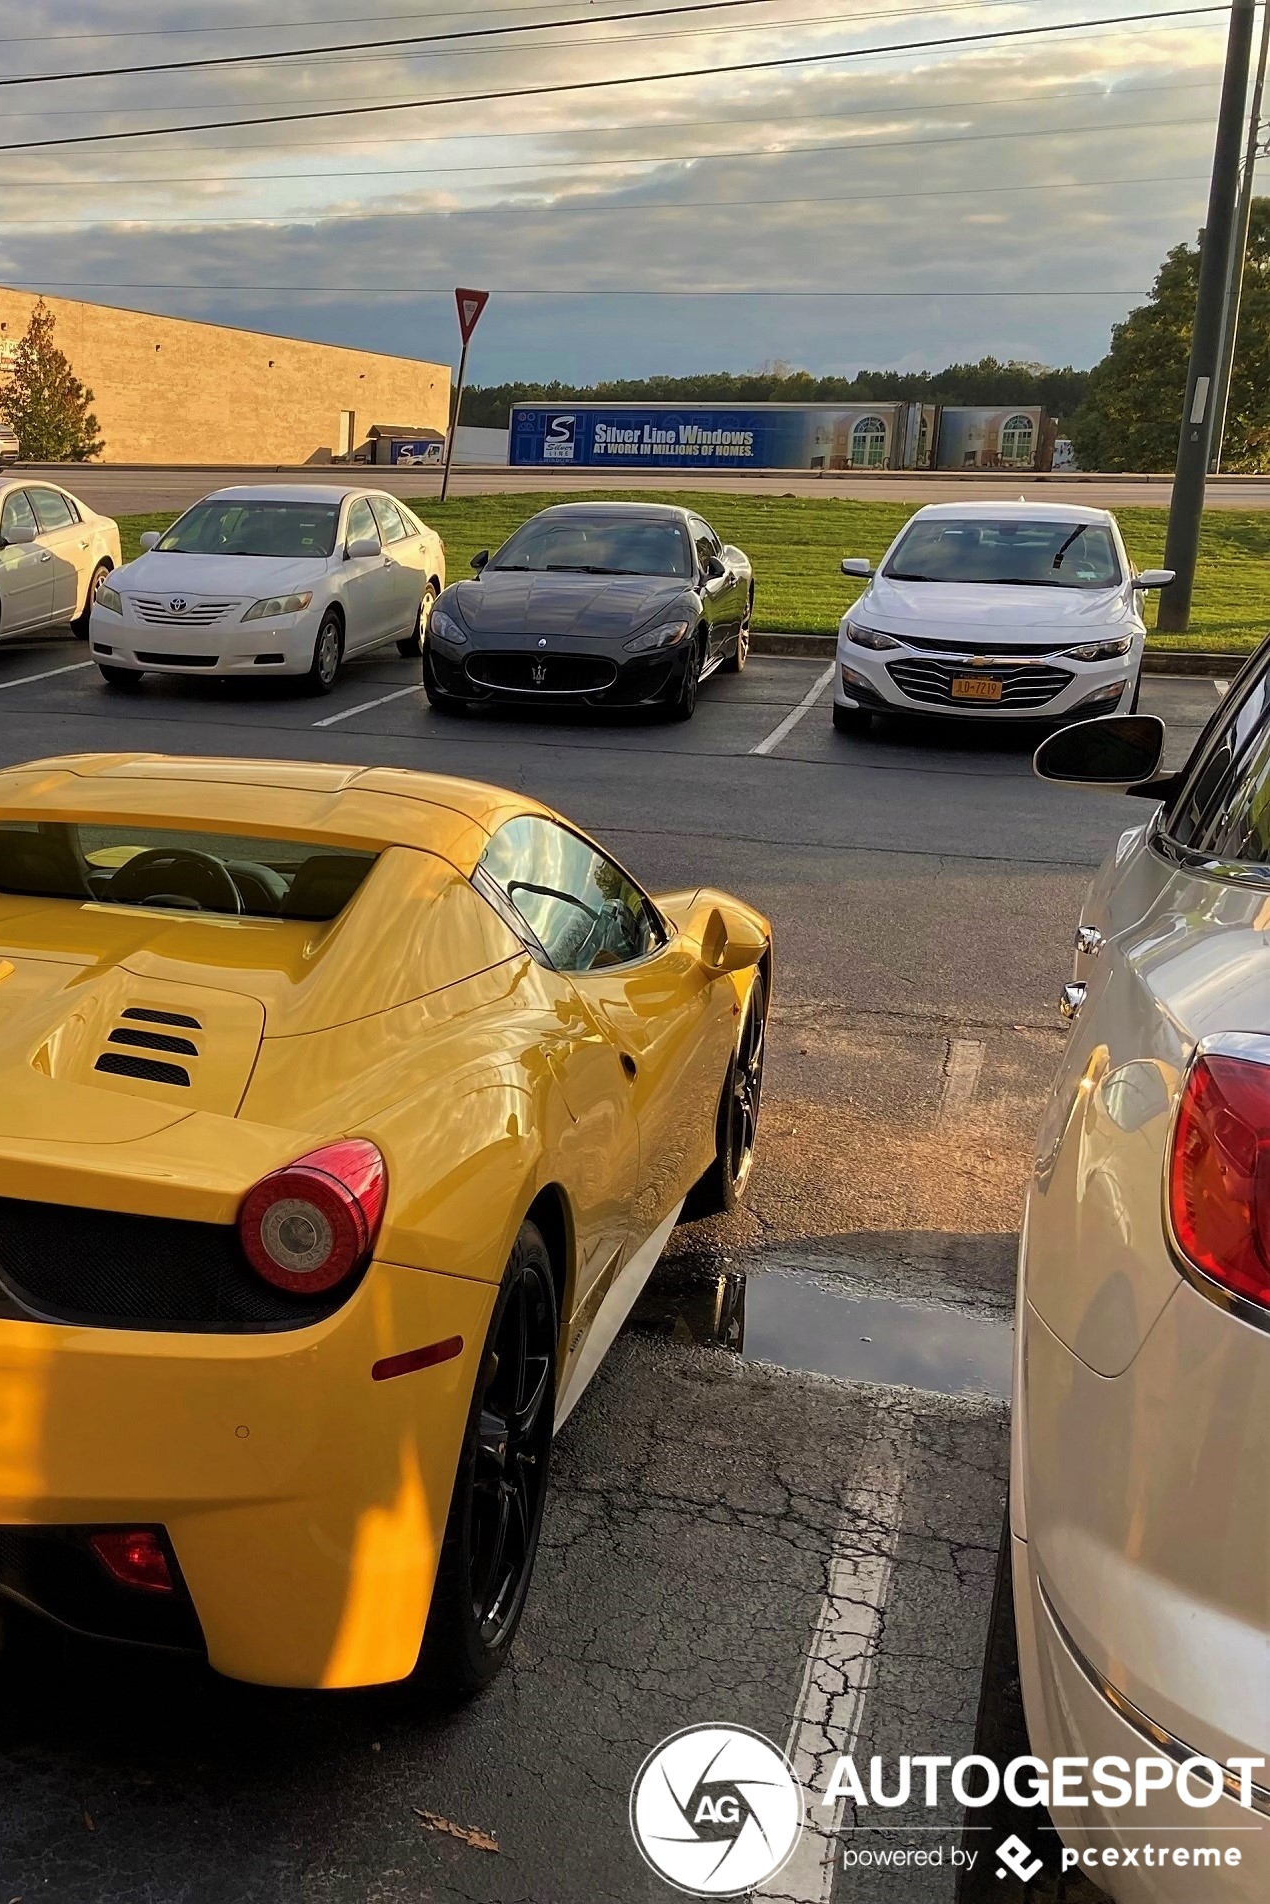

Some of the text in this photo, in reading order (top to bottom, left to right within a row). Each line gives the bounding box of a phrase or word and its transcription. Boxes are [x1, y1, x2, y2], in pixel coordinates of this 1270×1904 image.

[546, 415, 575, 443] S
[594, 423, 754, 445] Silver Line Windows
[545, 443, 573, 451] Silver
[593, 443, 754, 457] AT WORK IN MILLIONS OF HOMES.
